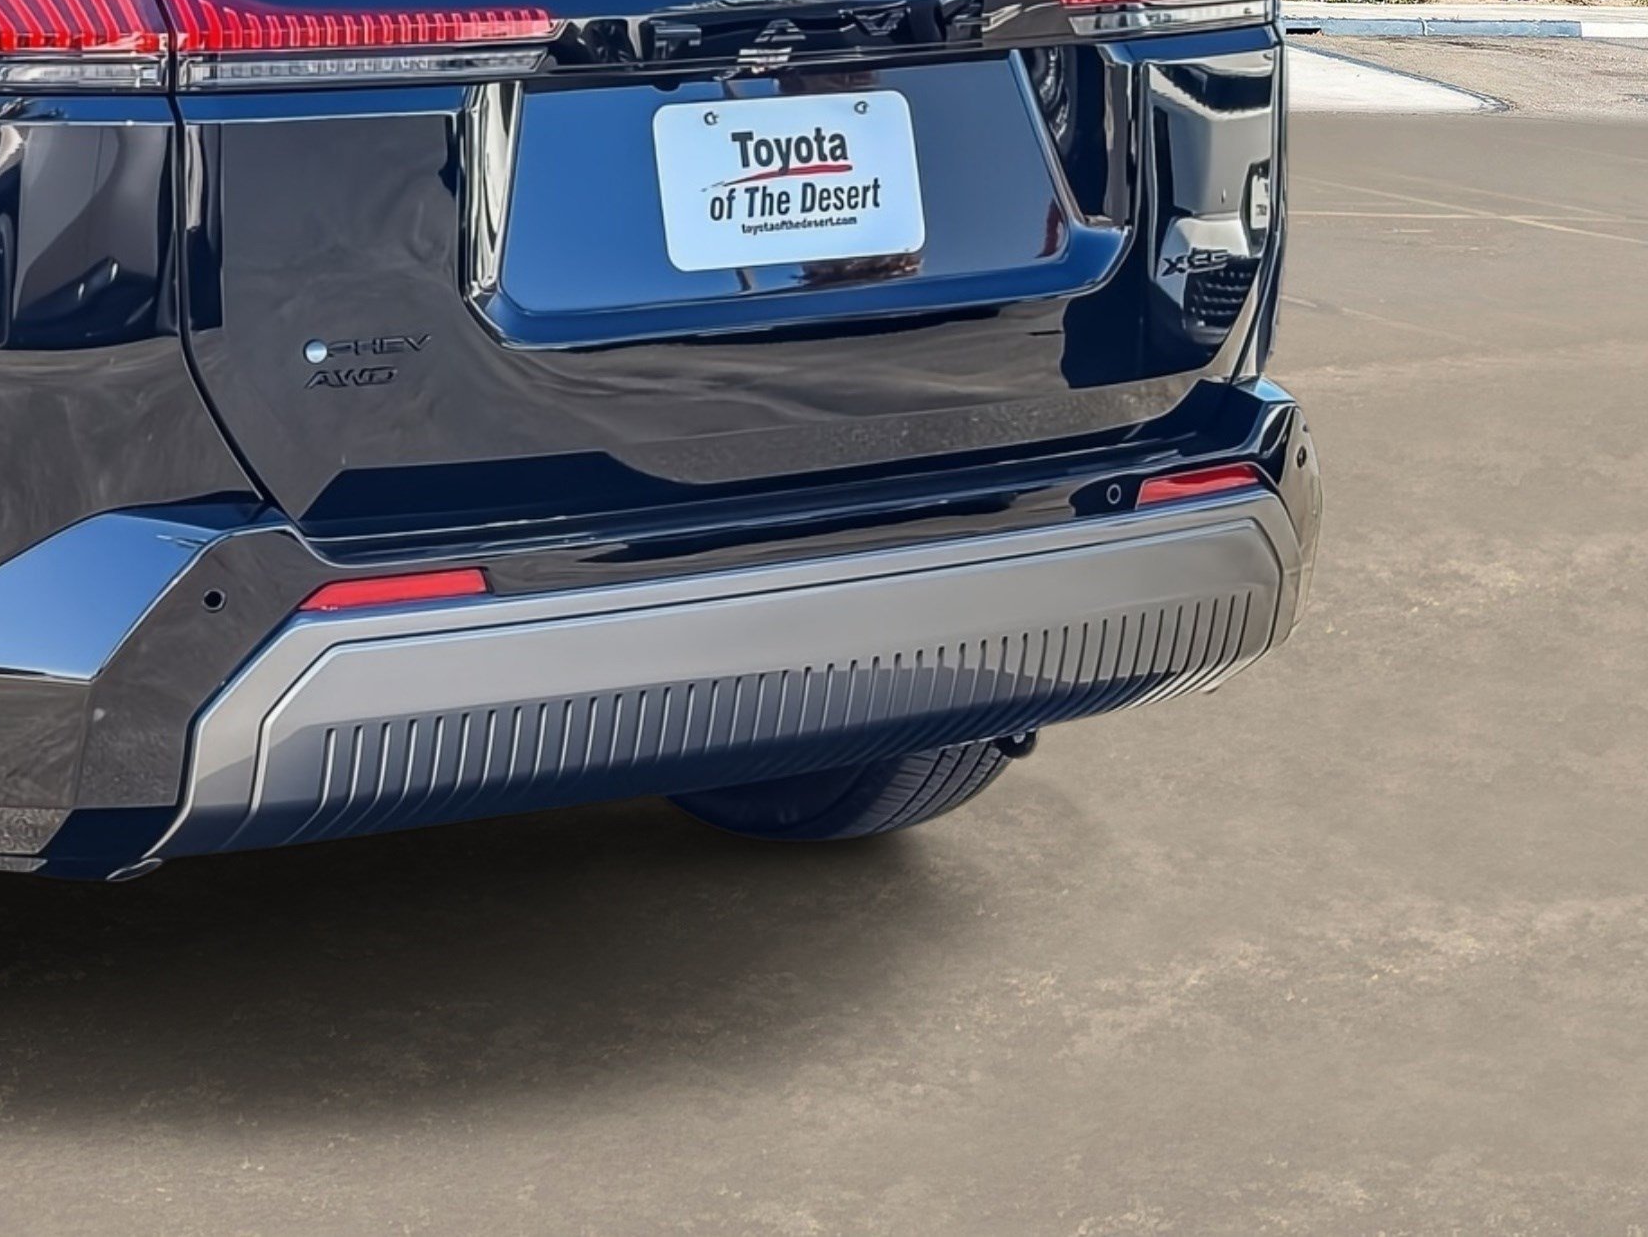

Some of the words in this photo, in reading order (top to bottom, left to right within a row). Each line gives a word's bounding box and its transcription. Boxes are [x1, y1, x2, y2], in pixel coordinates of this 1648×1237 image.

[731, 127, 848, 175] Toyota
[710, 188, 736, 221] of
[744, 185, 790, 218] The
[800, 178, 881, 213] Desert
[304, 366, 398, 389] AWD
